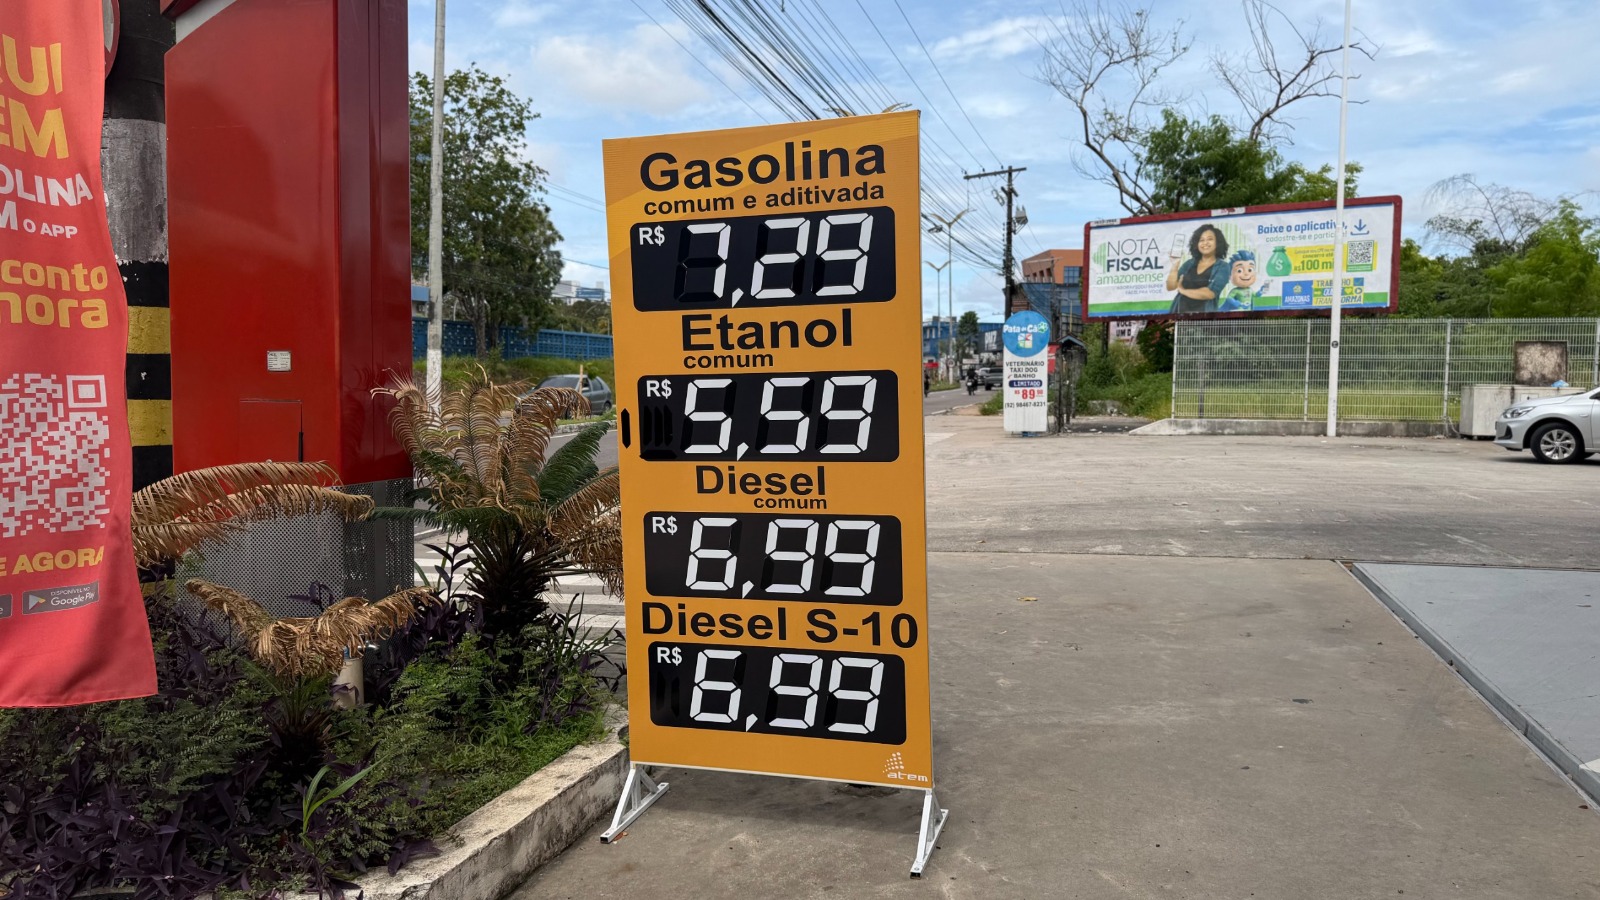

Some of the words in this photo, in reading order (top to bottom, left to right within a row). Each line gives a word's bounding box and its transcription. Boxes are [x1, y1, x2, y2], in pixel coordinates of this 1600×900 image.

[0, 34, 63, 96] UI
[640, 140, 886, 191] Gasolina
[643, 194, 734, 215] comum
[743, 195, 757, 208] e
[765, 182, 885, 208] aditivada
[23, 218, 36, 233] O
[40, 222, 78, 238] APP
[1257, 224, 1284, 234] Baixe
[1294, 219, 1347, 233] aplicativ,
[1107, 238, 1160, 257] NOTA
[639, 226, 665, 246] R$
[685, 213, 874, 308] 7,29
[1106, 256, 1164, 273] FISCAL
[1300, 259, 1320, 271] 100
[1096, 272, 1164, 285] amazonense
[681, 308, 853, 351] Etanol
[1003, 324, 1021, 333] Pata
[683, 353, 774, 369] comum
[1021, 388, 1036, 400] 89
[646, 379, 672, 399] R$
[684, 375, 877, 461] 5,59
[696, 465, 826, 496] Diesel
[753, 497, 828, 509] comum
[651, 515, 678, 535] R$
[685, 517, 881, 599] 6,99
[50, 593, 85, 606] Google
[642, 602, 787, 640] Diesel
[806, 608, 918, 648] S-10
[656, 646, 683, 666] R$
[689, 649, 885, 734] 6,99
[887, 771, 928, 782] atem
